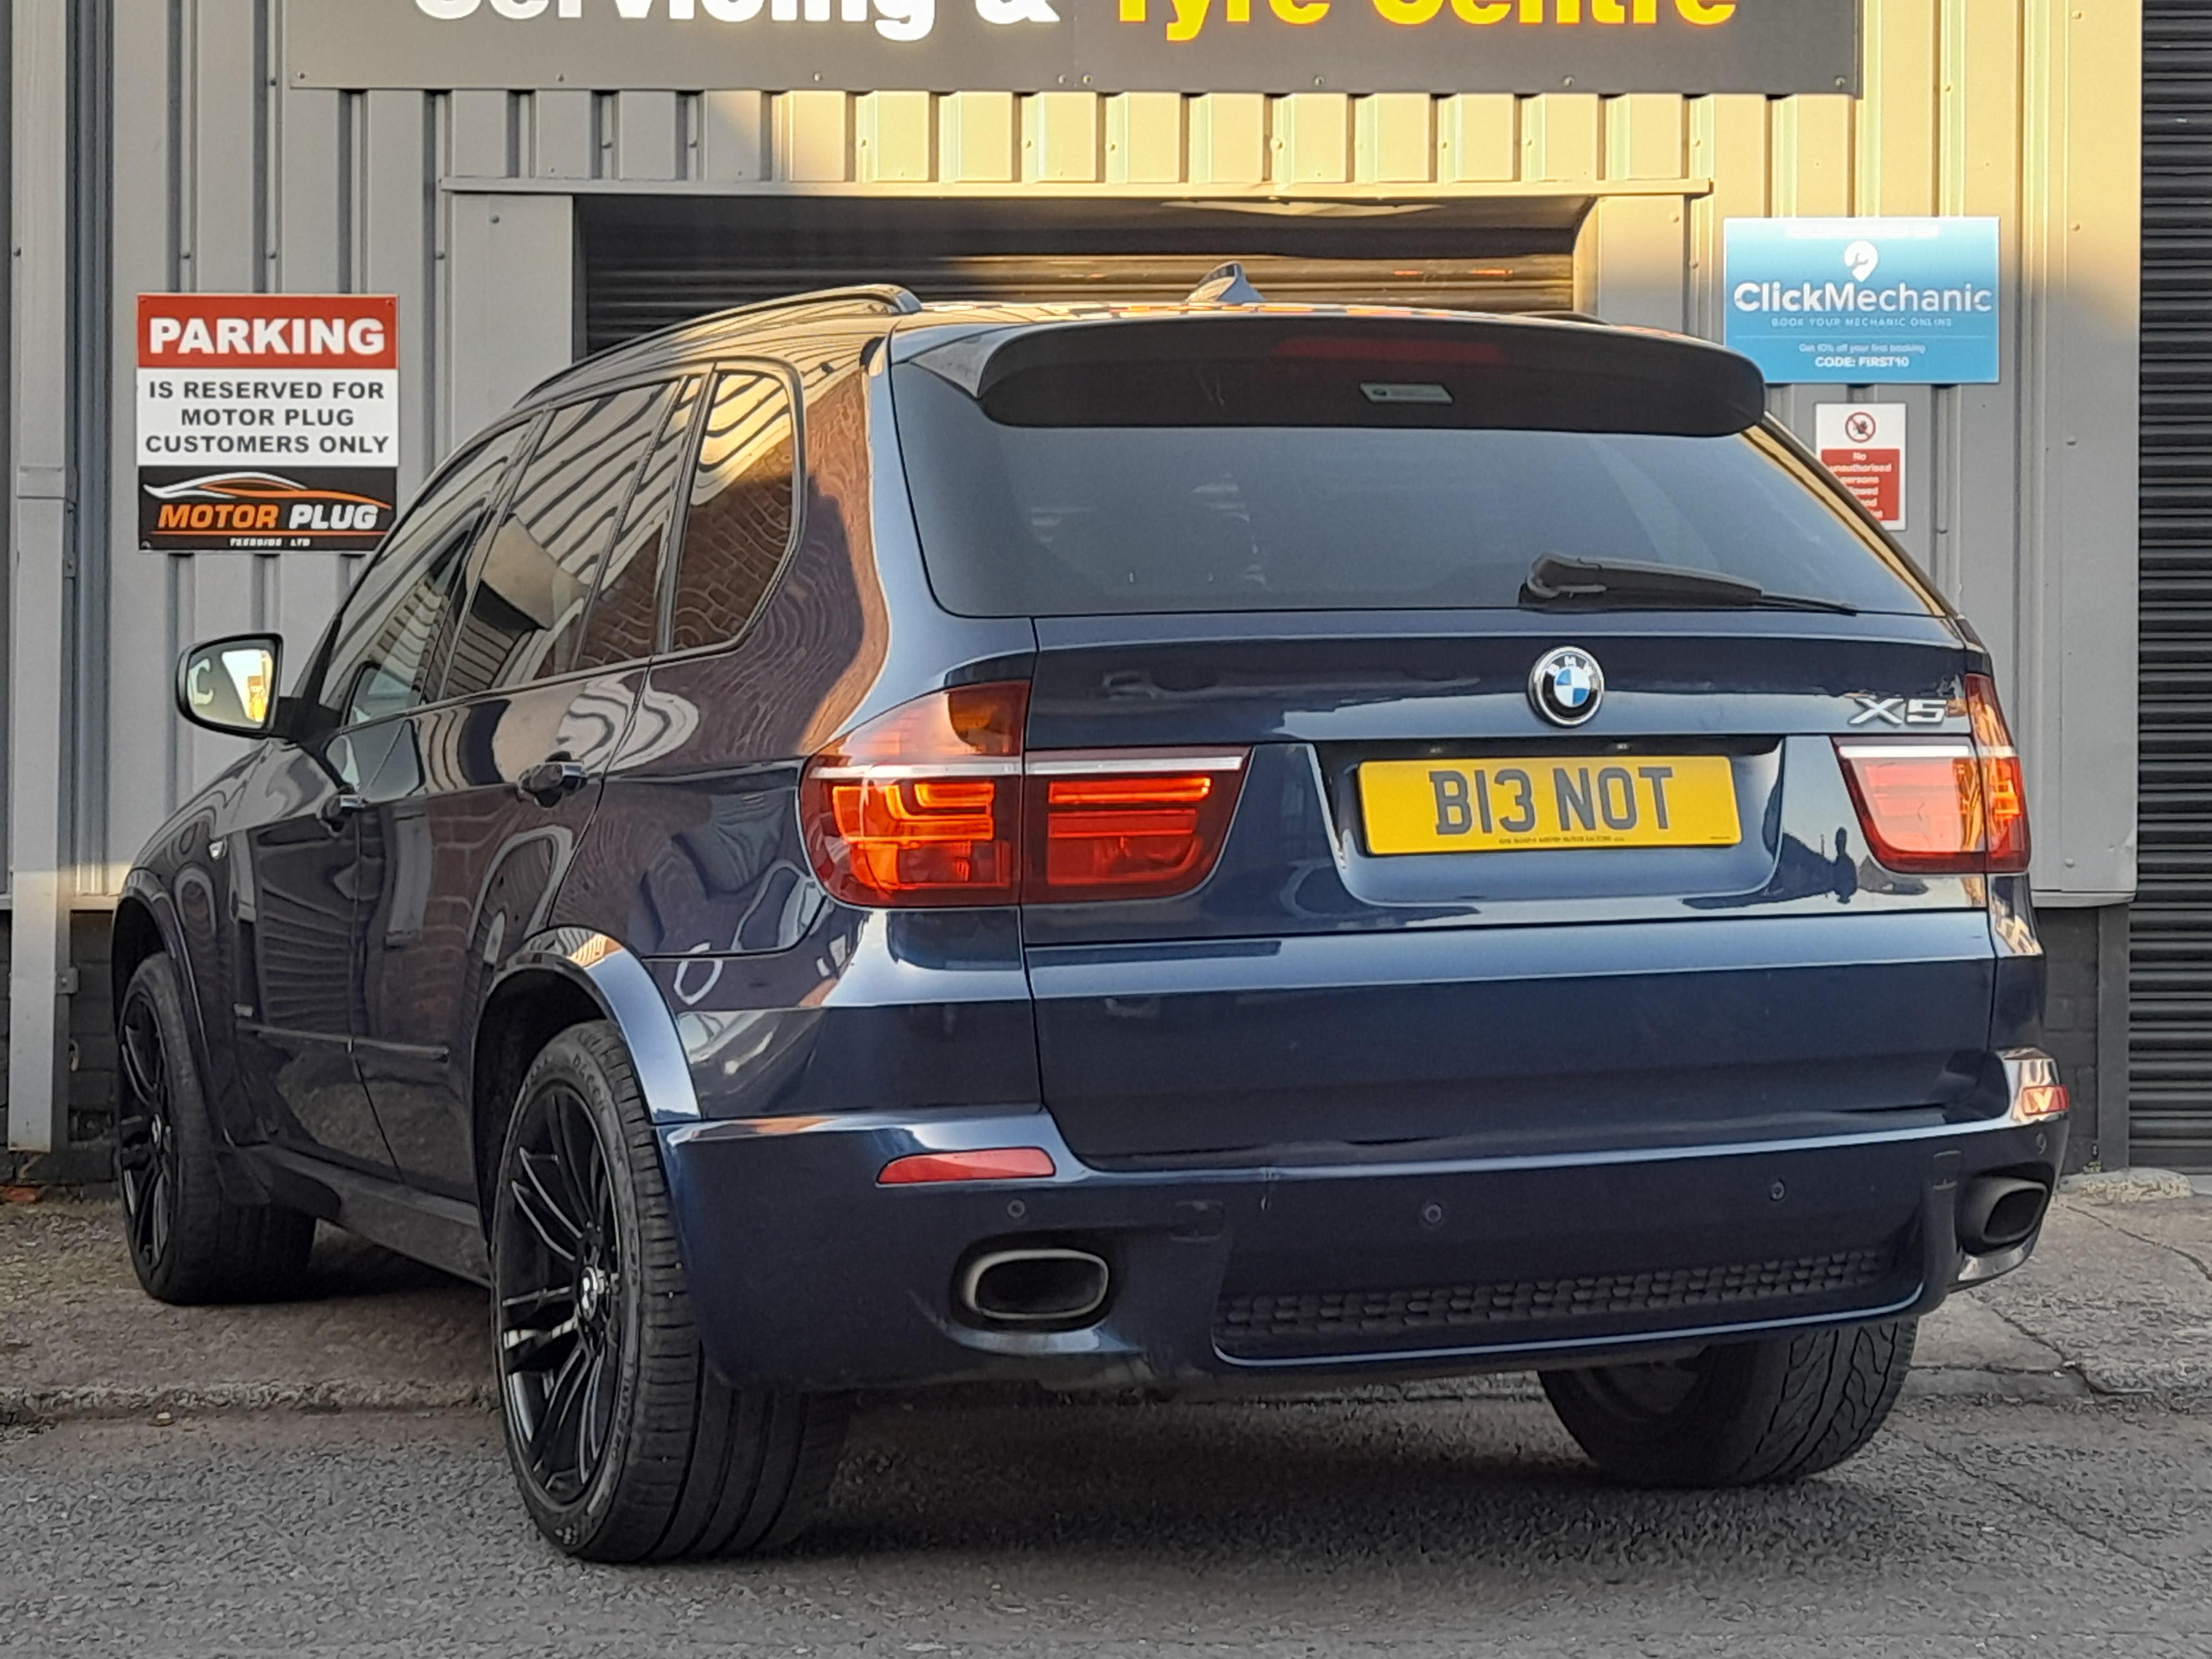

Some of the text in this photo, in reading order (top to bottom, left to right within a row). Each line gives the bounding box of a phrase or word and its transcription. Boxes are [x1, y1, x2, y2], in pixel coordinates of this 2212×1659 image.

[1734, 282, 1992, 312] ClickMechanic
[1771, 317, 1952, 327] BOOK YOUR MECHANIC ONLINE
[149, 317, 385, 355] PARKING
[1814, 356, 1910, 368] CODE: FIRST10
[149, 381, 384, 399] IS RESERVED FOR
[181, 409, 354, 427] MOTOR PLUG
[145, 435, 389, 453] CUSTOMERS ONLY
[157, 504, 378, 529] MOTOR PLUG
[1848, 697, 1947, 725] X5
[1429, 766, 1673, 835] B13 NOT
